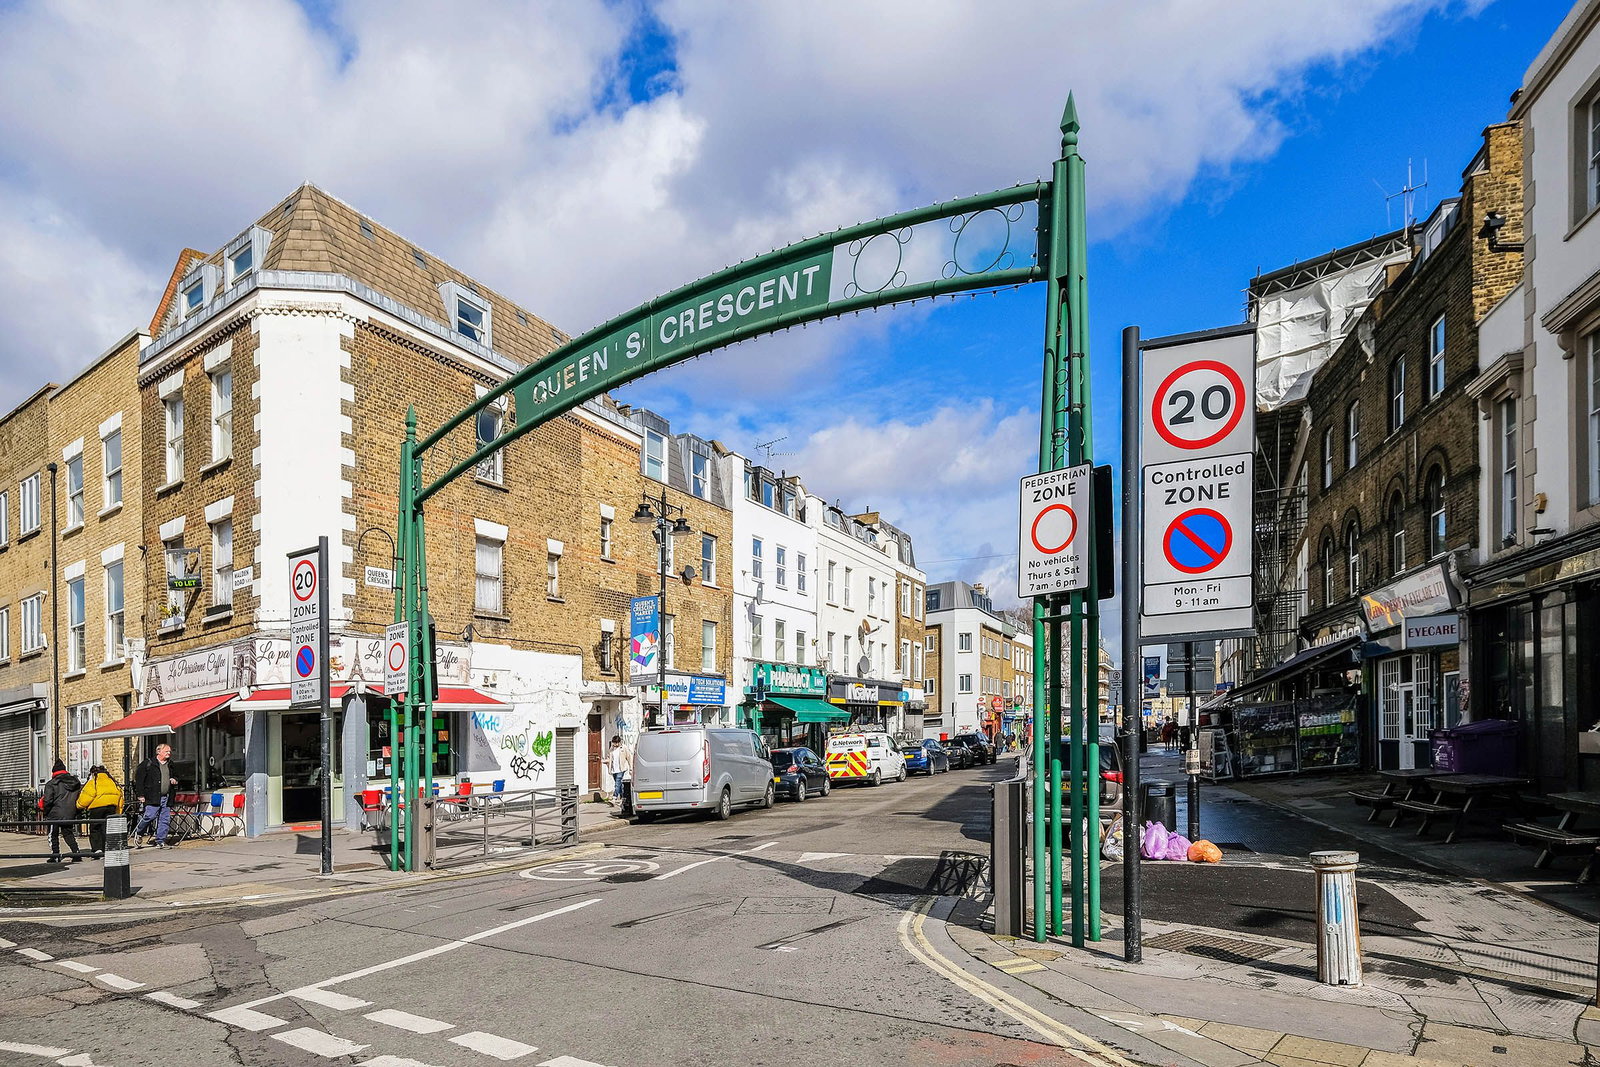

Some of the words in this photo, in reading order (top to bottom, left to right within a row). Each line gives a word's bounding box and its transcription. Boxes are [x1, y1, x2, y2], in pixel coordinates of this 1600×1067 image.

[659, 264, 820, 344] CRESCENT
[1168, 385, 1231, 426] 20
[1025, 468, 1087, 489] PEDESTRIAN
[1151, 461, 1245, 485] Controlled
[1033, 482, 1077, 503] ZONE
[1164, 482, 1230, 505] ZONE
[1028, 560, 1040, 569] No
[1043, 554, 1080, 566] vehicles
[296, 570, 313, 591] 20
[367, 569, 389, 579] QUEEN'S
[1028, 571, 1052, 581] Thurs
[1055, 568, 1061, 577] &
[1064, 565, 1080, 575] Sat
[234, 579, 245, 587] ROAD
[367, 576, 390, 586] CRESCENT
[1174, 587, 1197, 596] Mon
[1206, 583, 1221, 593] Fri
[1409, 585, 1433, 606] EYECARE
[1433, 581, 1446, 597] LTD
[293, 603, 317, 618] ZONE
[1175, 599, 1182, 608] 9
[291, 622, 319, 634] Controlled
[387, 623, 408, 633] PEDESTRIAN
[389, 630, 405, 641] ZONE
[1407, 624, 1457, 638] EYECARE
[295, 633, 315, 644] ZONE
[256, 641, 275, 665] La
[364, 640, 383, 664] La
[436, 647, 459, 669] Coffee
[770, 670, 811, 689] PHARMACY
[832, 739, 863, 747] G.Network
